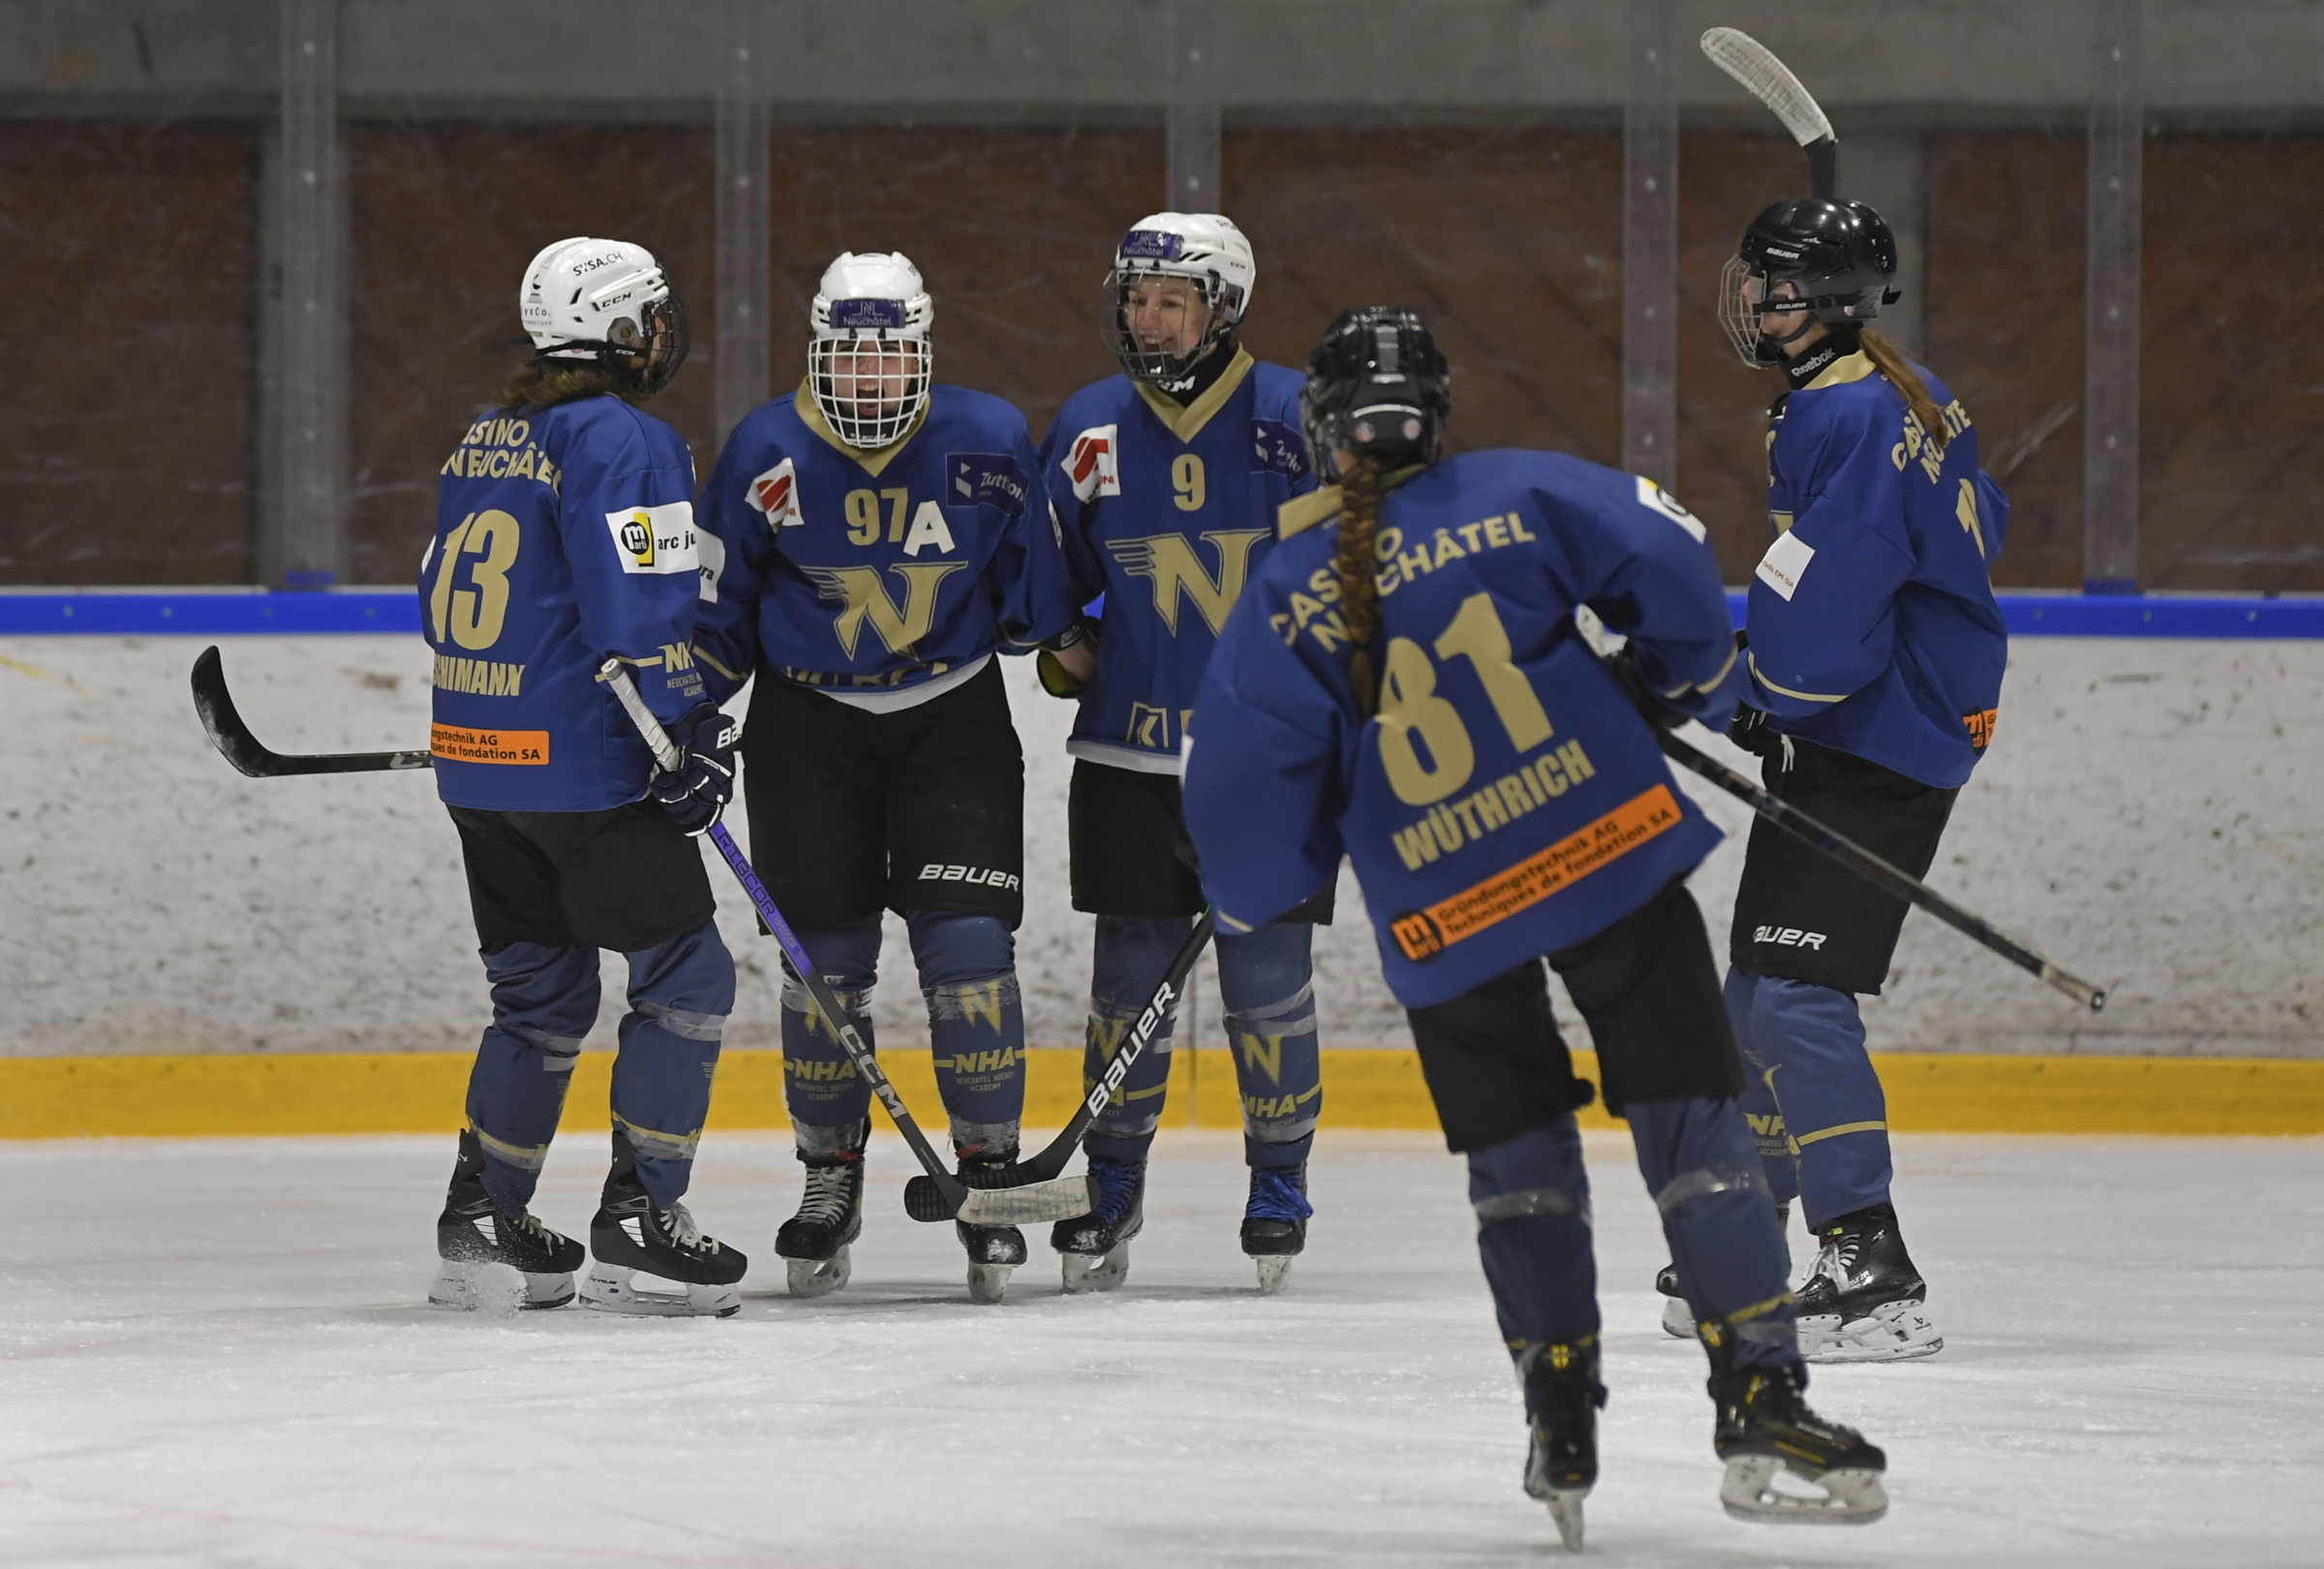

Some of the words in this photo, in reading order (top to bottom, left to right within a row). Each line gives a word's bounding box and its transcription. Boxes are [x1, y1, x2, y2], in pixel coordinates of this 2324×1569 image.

[601, 292, 632, 308] CCM
[1790, 348, 1836, 378] Reebok
[1170, 452, 1207, 511] 9
[658, 536, 680, 550] arc
[843, 488, 908, 546] 97
[902, 500, 956, 557] A
[431, 509, 520, 650] 13
[1375, 592, 1554, 806] 81
[446, 744, 457, 755] de
[458, 745, 517, 759] fondation
[521, 749, 541, 760] SA
[479, 735, 498, 746] AG
[1391, 738, 1597, 872] WÜTHRICH
[1595, 820, 1618, 841] AG
[718, 832, 776, 917] RIBCOR
[1542, 873, 1562, 891] de
[1566, 824, 1648, 875] fondation
[1650, 808, 1673, 827] SA
[792, 1058, 857, 1081] NHA
[840, 1024, 909, 1119] CCM
[952, 1046, 1016, 1074] NHA
